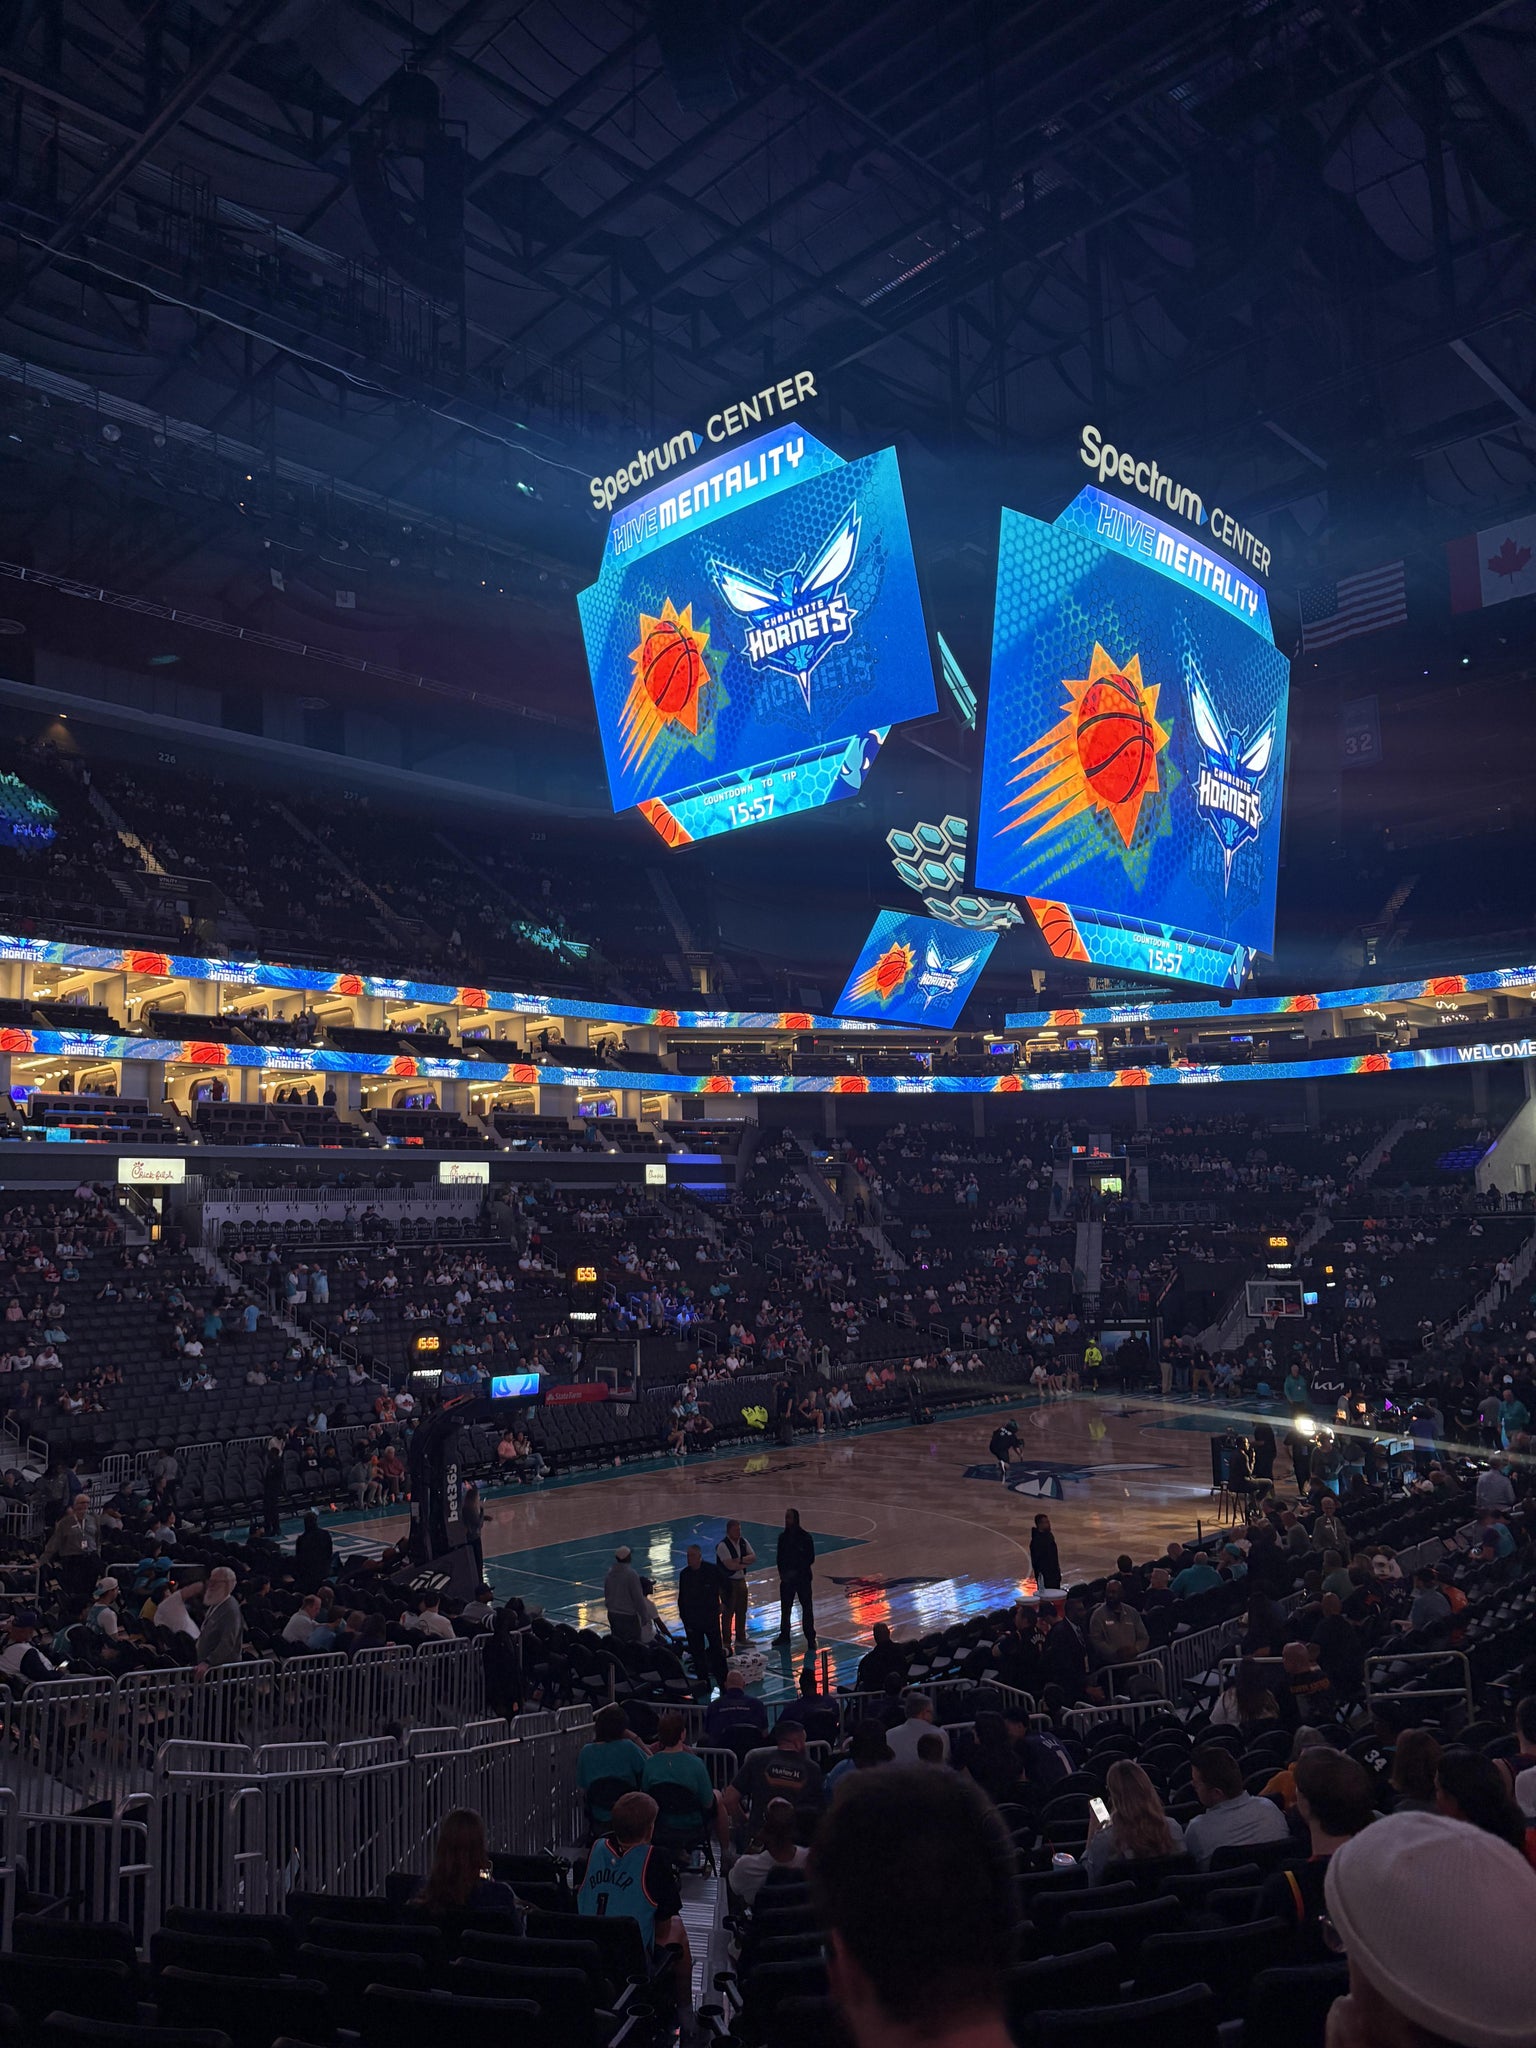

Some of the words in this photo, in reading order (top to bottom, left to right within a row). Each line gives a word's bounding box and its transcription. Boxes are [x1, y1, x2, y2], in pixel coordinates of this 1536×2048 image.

[590, 430, 697, 512] Spectrum
[707, 370, 818, 443] CENTER
[1080, 424, 1202, 526] Spectrum
[1210, 507, 1271, 578] CENTER
[763, 599, 824, 629] CHARLOTTE
[749, 599, 849, 662] HORNETS
[1345, 733, 1373, 754] 32
[703, 784, 754, 806] COUNTDOWN
[761, 777, 774, 789] TO
[782, 771, 797, 782] TIP
[1213, 767, 1251, 793] CHARLOTTE
[728, 793, 775, 826] 15:57
[1199, 769, 1261, 830] HORNETS
[1133, 933, 1170, 949] COUNTDOWN
[2, 948, 44, 962] HORNETS
[1148, 948, 1183, 975] 15:57
[210, 970, 255, 984] HORNETS
[919, 973, 957, 991] HORNETS
[842, 1022, 876, 1030] HORNETS
[1112, 1013, 1149, 1023] HORNETS
[64, 1044, 105, 1057] HORNETS
[1458, 1041, 1536, 1061] WELCOME
[268, 1057, 313, 1070] HORNETS
[897, 1085, 933, 1093] HORNETS
[1181, 1074, 1220, 1083] HORNETS
[447, 1463, 459, 1523] bet365
[1364, 1749, 1388, 1773] 34
[589, 1869, 634, 1890] BOOKER
